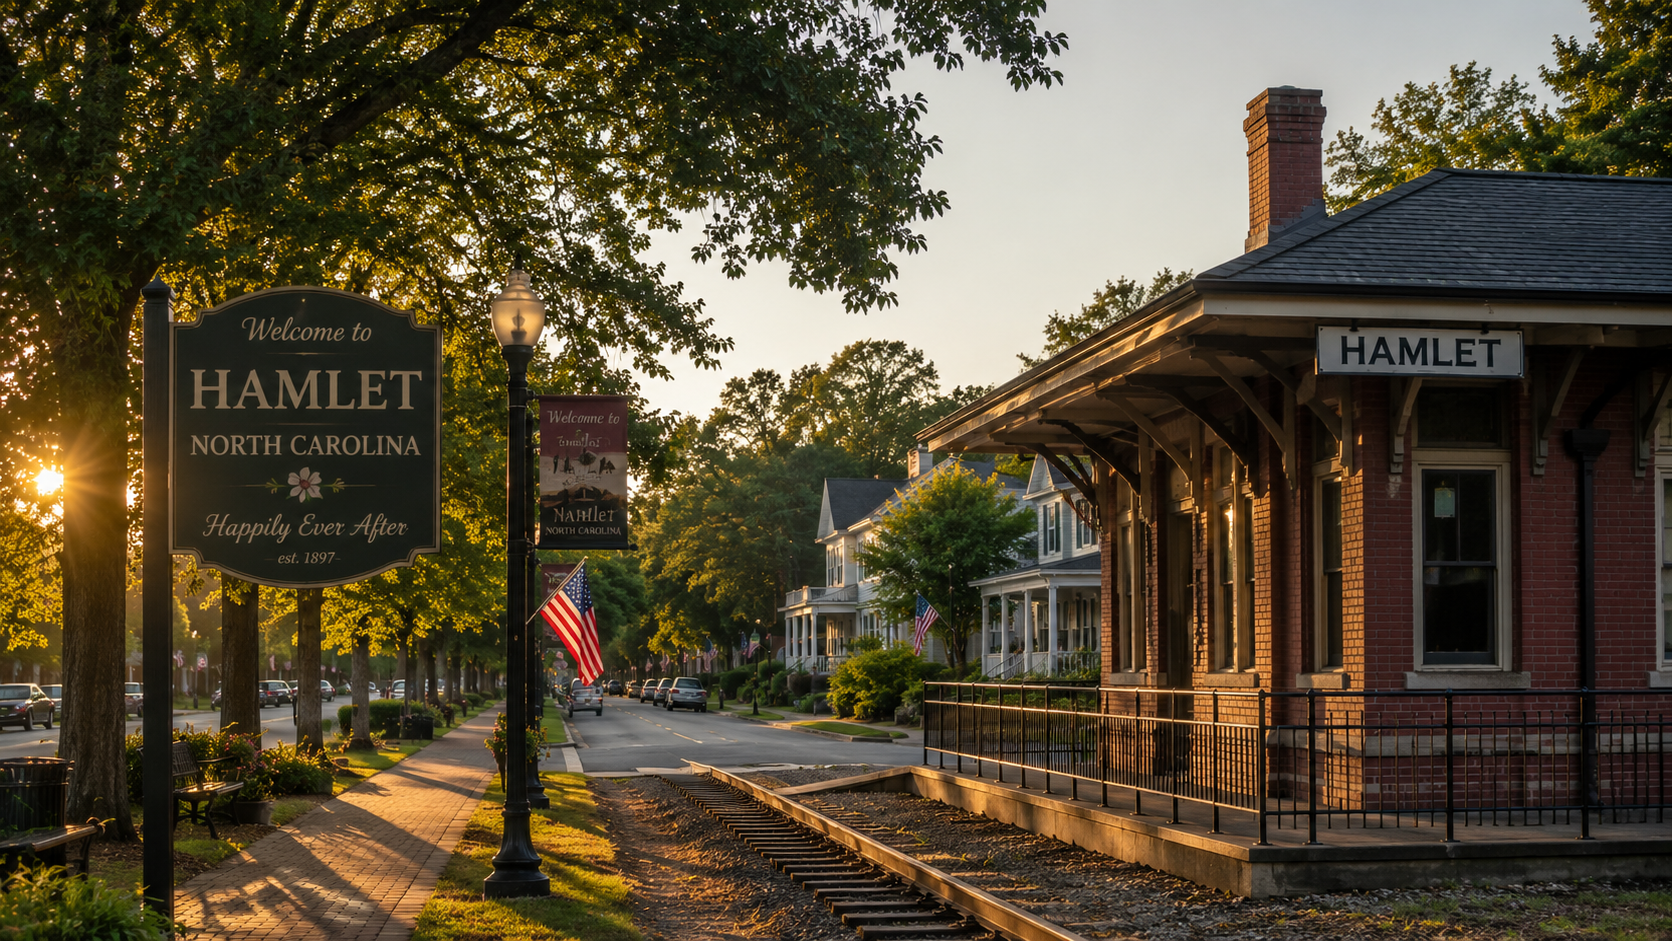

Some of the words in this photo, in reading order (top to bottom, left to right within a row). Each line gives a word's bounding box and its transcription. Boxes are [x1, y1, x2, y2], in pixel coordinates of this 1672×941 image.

[241, 316, 345, 342] Welcome
[352, 322, 372, 342] to
[1340, 335, 1501, 368] HAMLET
[190, 368, 422, 410] HAMLET
[608, 412, 620, 424] to
[190, 435, 282, 456] NORTH
[290, 435, 422, 456] CAROLINA
[202, 513, 291, 544] Happily
[298, 513, 345, 538] Ever
[349, 513, 409, 544] After
[545, 526, 576, 536] NORTH
[578, 526, 622, 536] CAROLINA
[277, 552, 300, 565] est.
